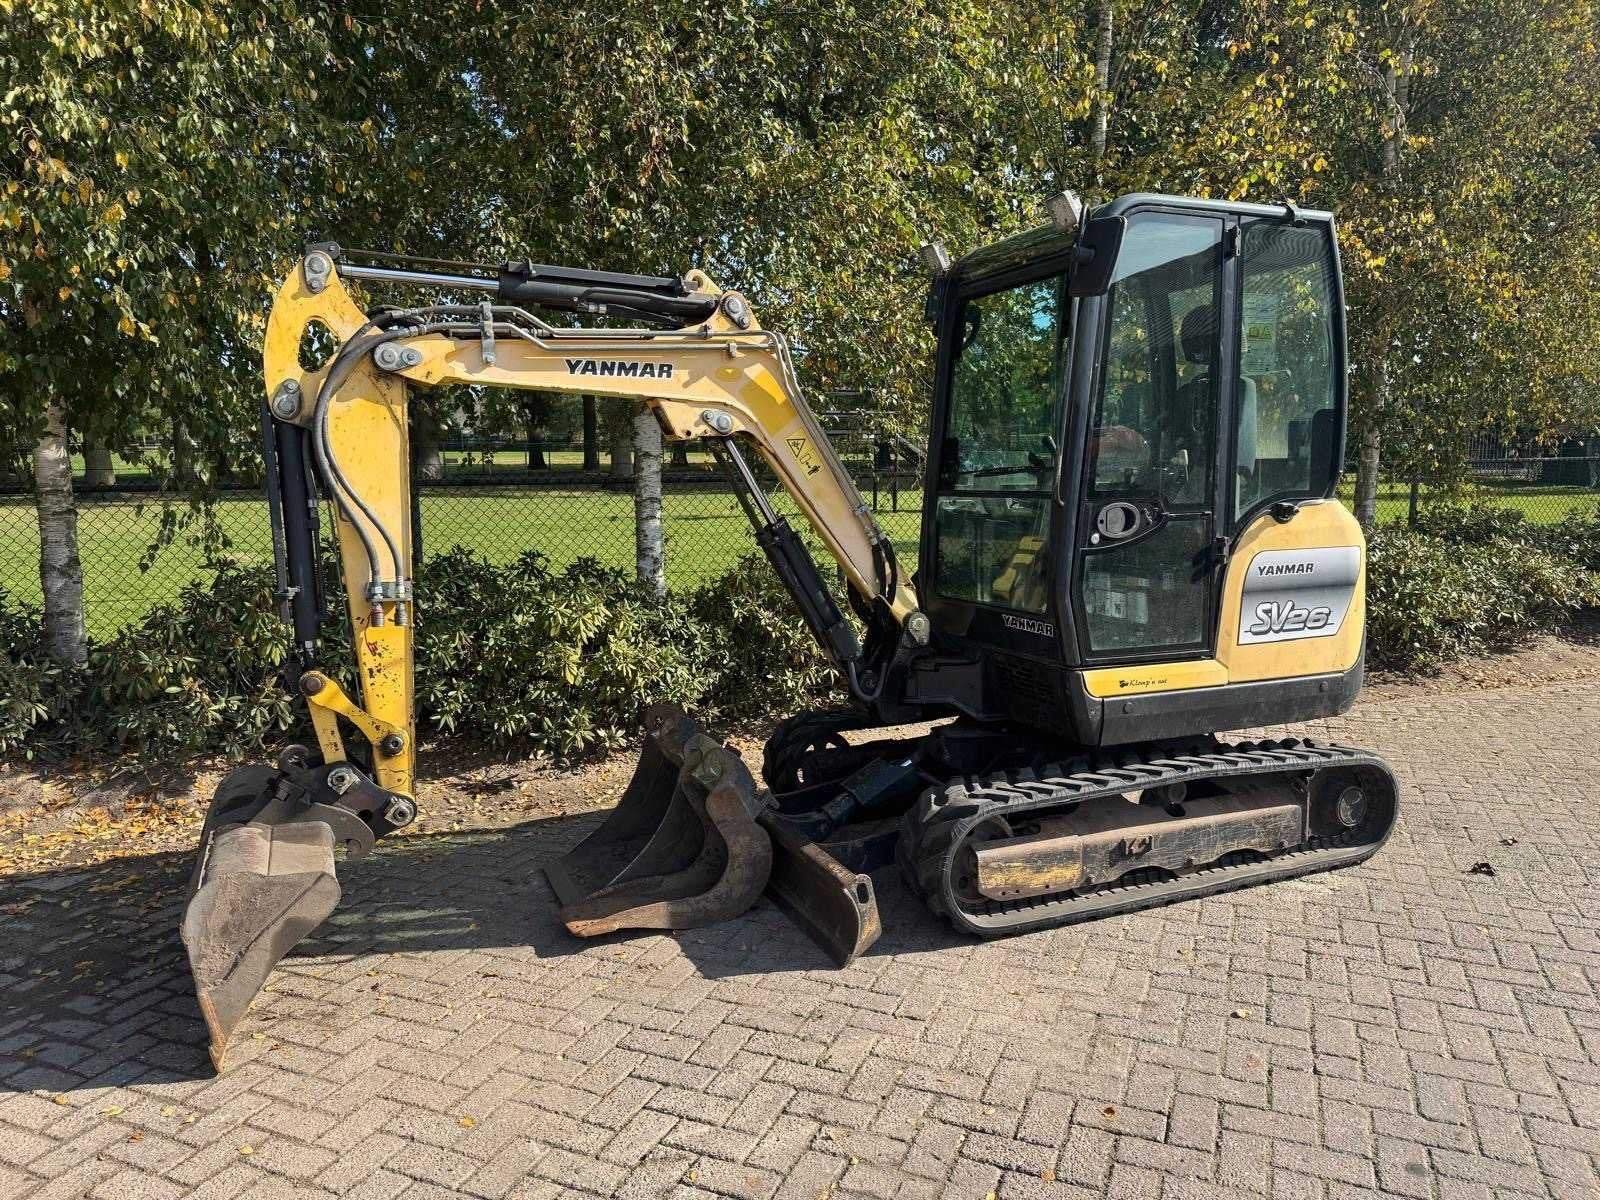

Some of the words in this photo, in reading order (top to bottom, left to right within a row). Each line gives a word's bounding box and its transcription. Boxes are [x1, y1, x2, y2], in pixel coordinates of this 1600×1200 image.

[564, 359, 673, 379] YANMAR
[1258, 563, 1314, 576] YANMAR
[1001, 613, 1054, 637] YANMAR
[1249, 599, 1332, 635] SV26
